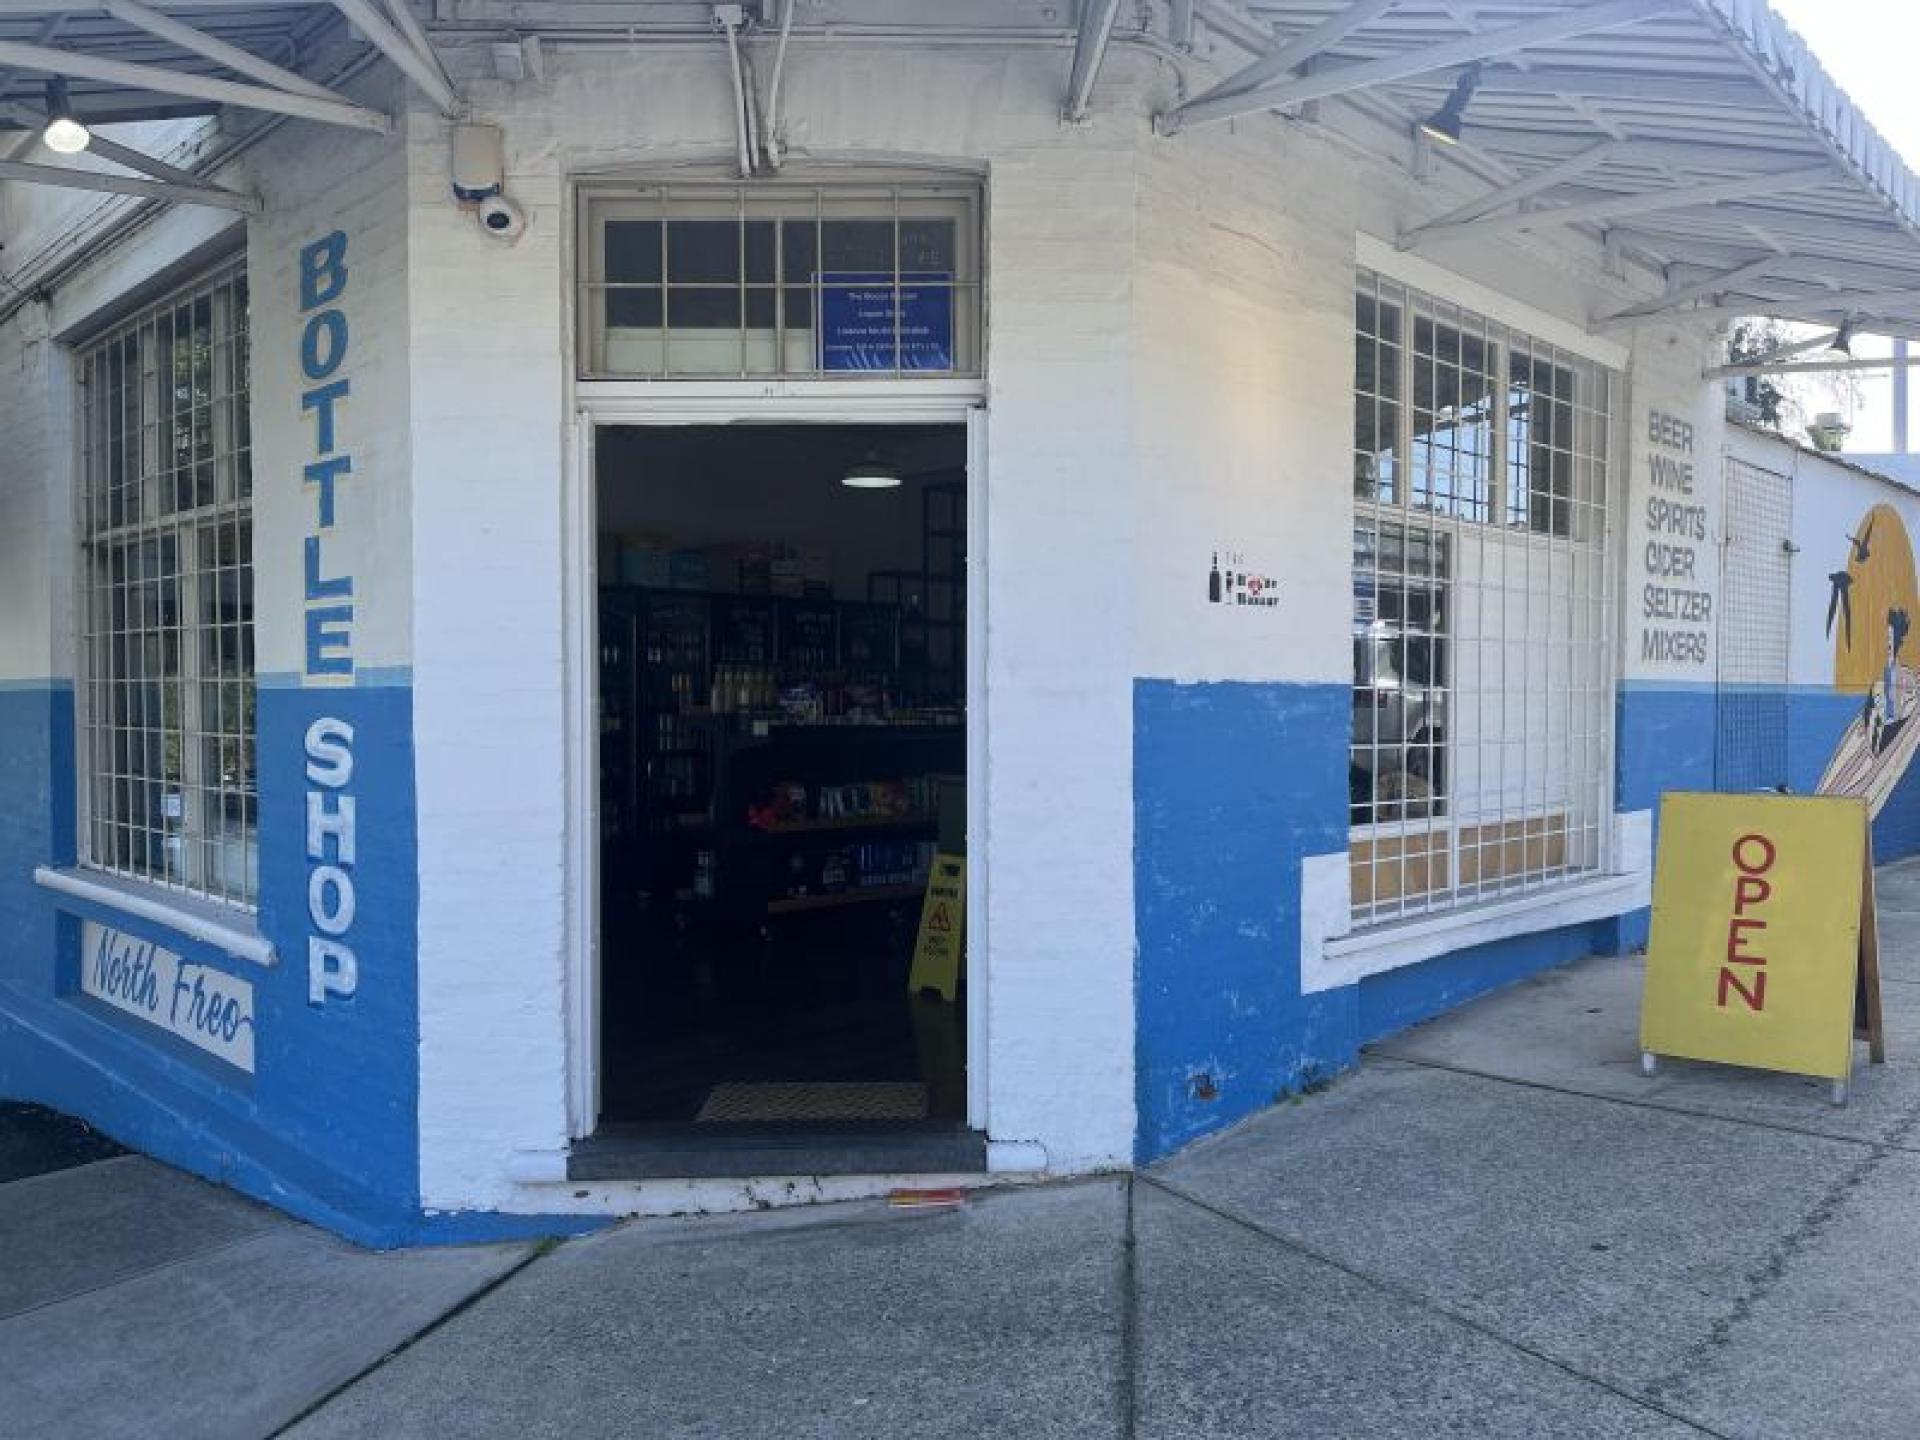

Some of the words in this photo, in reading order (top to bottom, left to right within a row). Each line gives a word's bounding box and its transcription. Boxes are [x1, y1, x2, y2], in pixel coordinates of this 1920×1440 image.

[299, 229, 354, 675] BOTTLE
[1648, 409, 1693, 455] BEER
[1648, 453, 1693, 495] WINE
[1646, 496, 1705, 541] SPIRITS
[1645, 540, 1695, 579] CIDER
[1643, 582, 1712, 623] SELTZER
[1641, 628, 1708, 665] MIXERS
[304, 716, 358, 1006] SHOP
[1717, 834, 1777, 1011] OPEN
[93, 928, 159, 1011] North
[170, 959, 253, 1043] Freo
